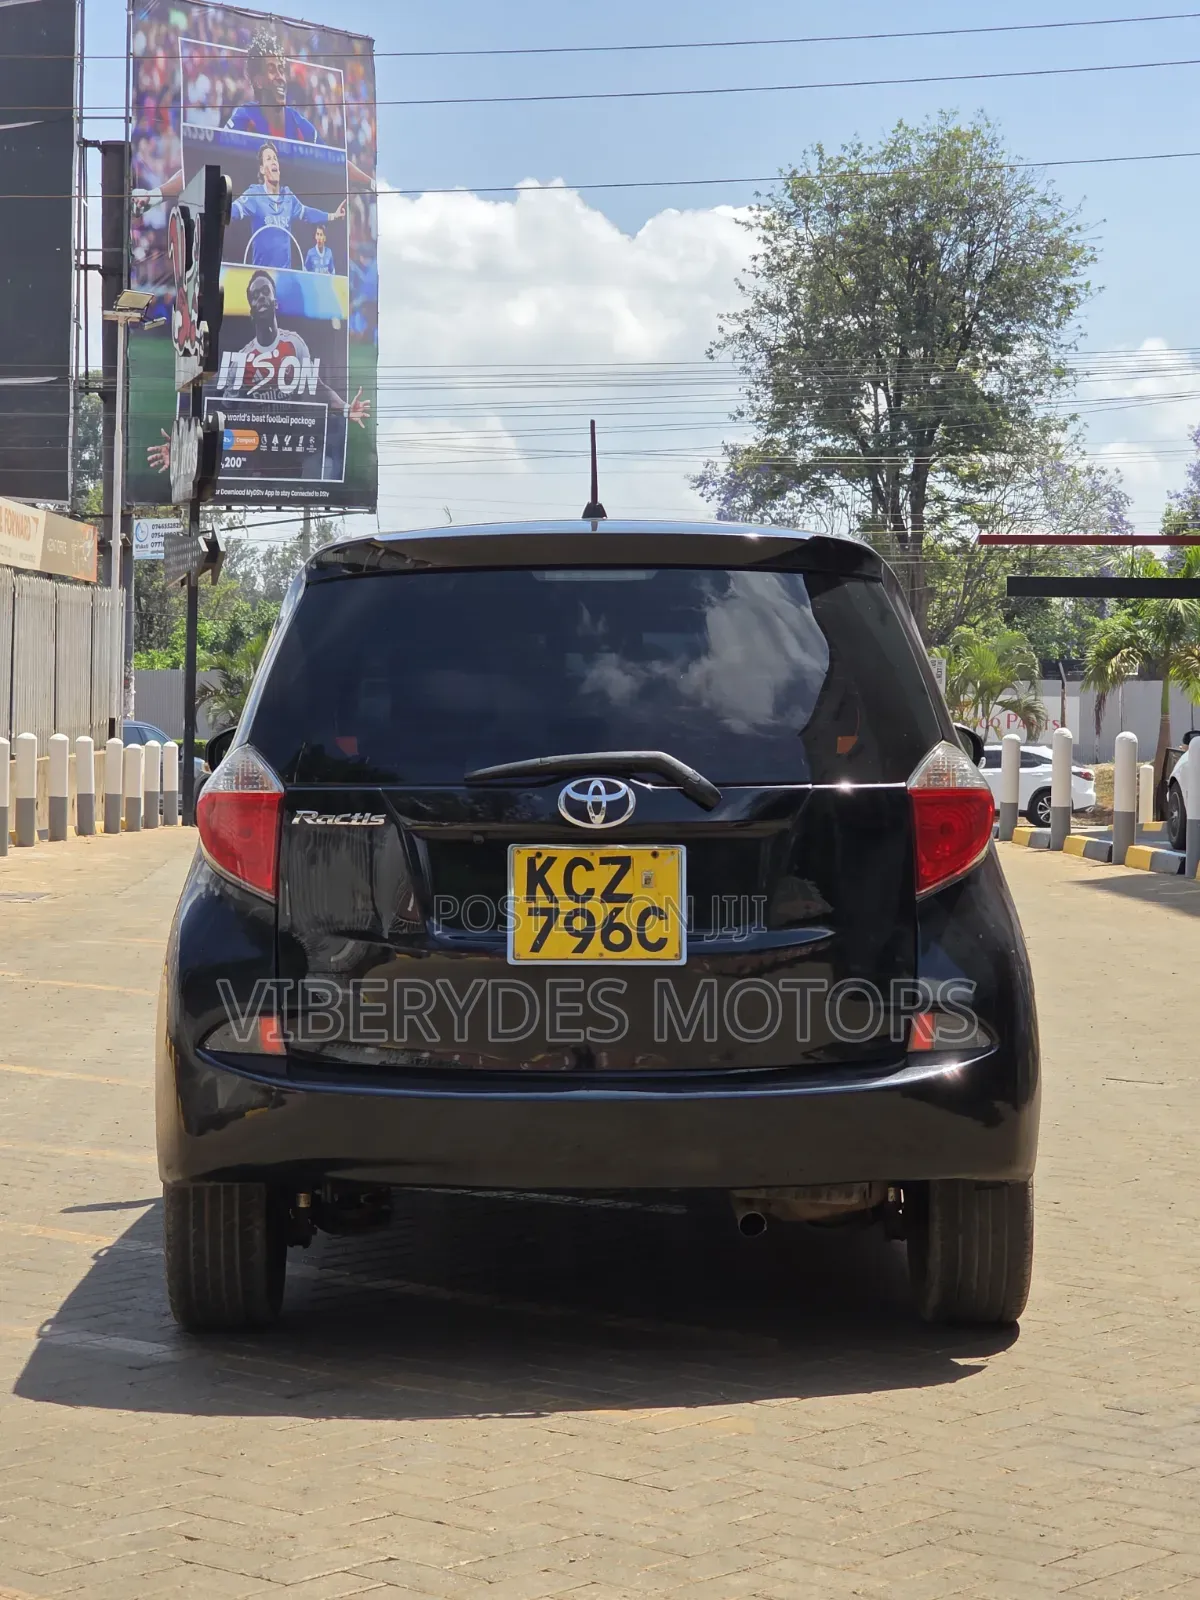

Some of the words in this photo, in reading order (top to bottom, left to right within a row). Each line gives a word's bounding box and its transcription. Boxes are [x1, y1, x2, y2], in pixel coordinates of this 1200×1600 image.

[217, 351, 276, 395] IT'S
[278, 355, 320, 395] ON
[227, 413, 250, 422] world's
[251, 413, 266, 423] best
[266, 414, 290, 424] football
[289, 416, 316, 427] package
[264, 489, 274, 497] App
[291, 810, 387, 825] Ractis
[525, 856, 634, 904] KCZ
[527, 905, 669, 954] 796C
